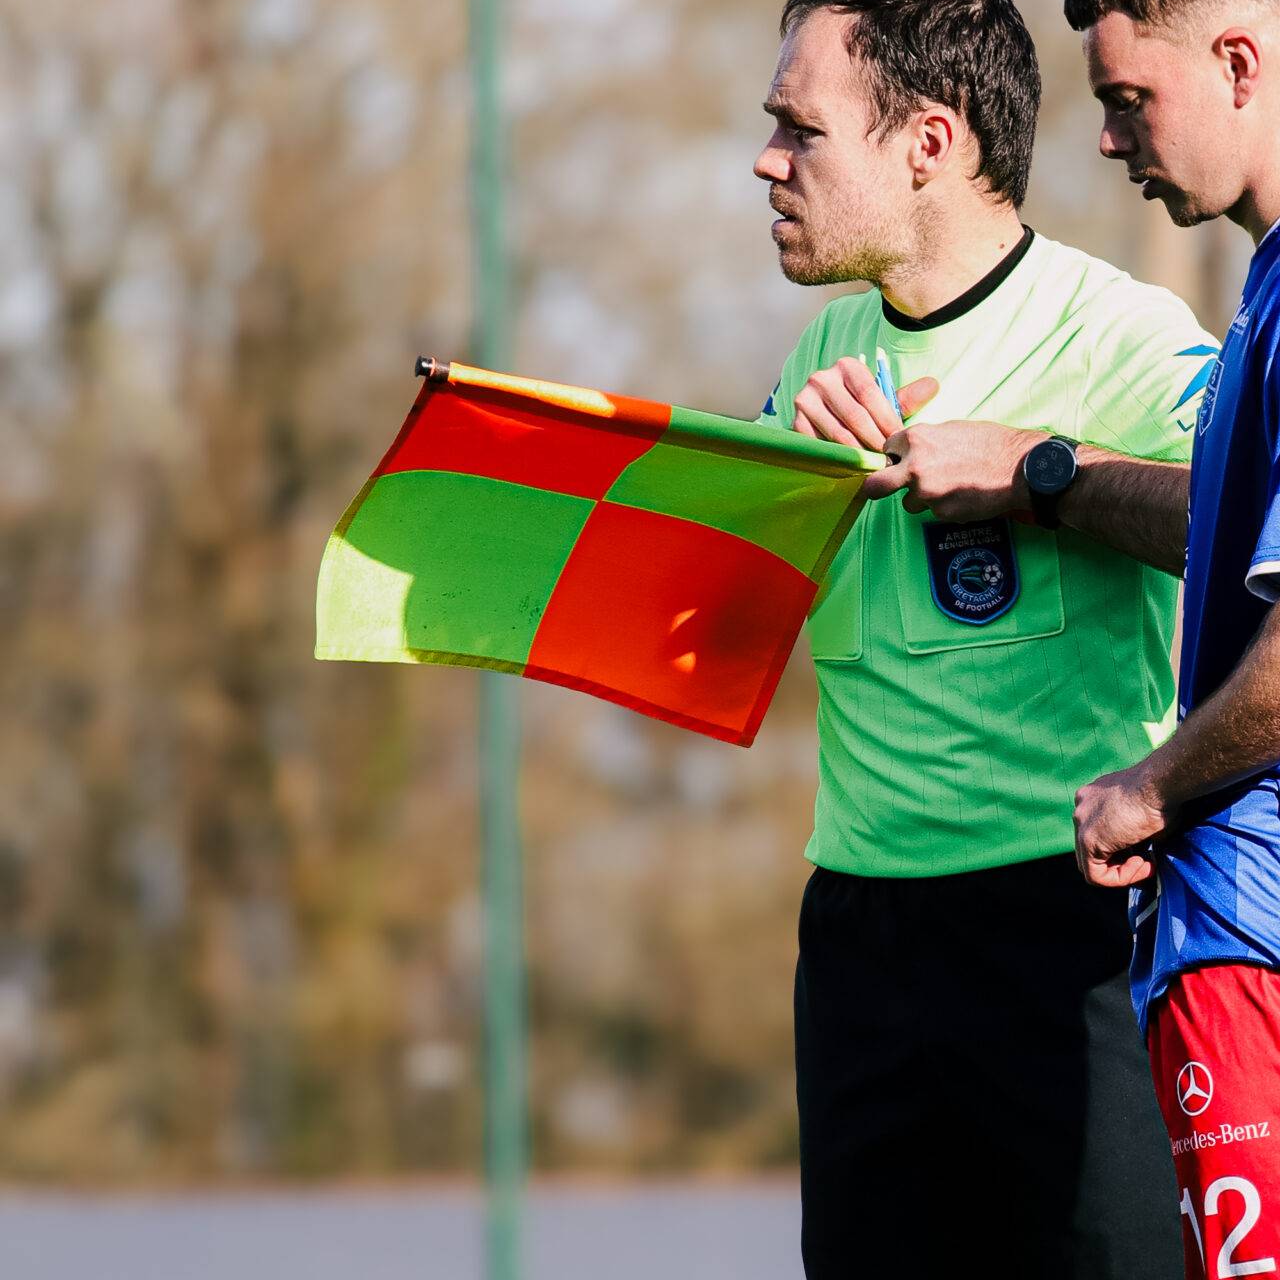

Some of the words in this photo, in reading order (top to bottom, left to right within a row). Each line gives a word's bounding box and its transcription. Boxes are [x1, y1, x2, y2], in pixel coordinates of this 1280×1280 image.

[945, 526, 993, 541] ARBITRE
[951, 551, 974, 570] LIGUE
[974, 550, 986, 559] DE
[952, 583, 998, 603] BRETAGNE
[954, 600, 965, 610] DE
[965, 595, 1005, 612] FOOTBALL
[1179, 1175, 1277, 1280] 12
